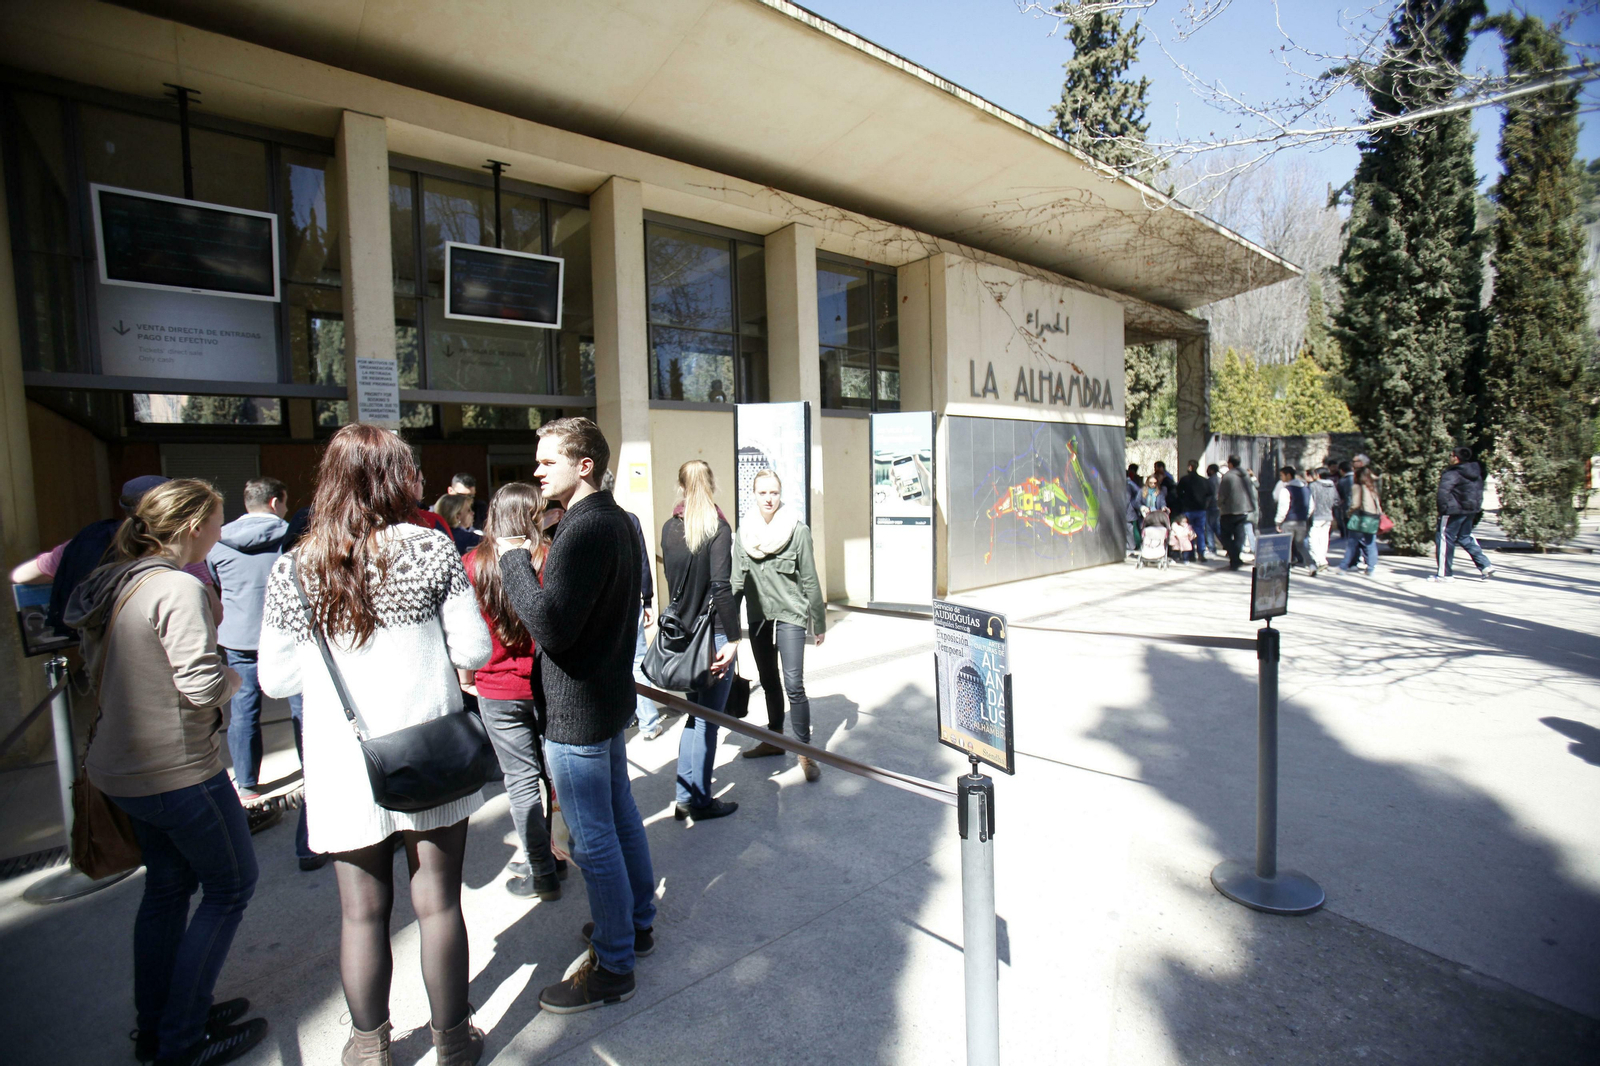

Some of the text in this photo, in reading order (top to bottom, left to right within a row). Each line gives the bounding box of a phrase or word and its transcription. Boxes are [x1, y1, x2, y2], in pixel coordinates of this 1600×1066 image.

[136, 323, 262, 340] VENTA DIRECTA DE ENTRADAS
[137, 333, 218, 346] PAGO EN EFECTIVO
[138, 355, 174, 364] Only cash
[167, 348, 188, 356] direct
[969, 359, 1114, 411] LA ALHAMBRA
[934, 601, 953, 612] Servicio
[934, 610, 981, 628] AUDIOGUÍAS
[936, 628, 969, 646] Exposición
[988, 641, 1001, 650] ARTE
[936, 640, 964, 658] Temporal
[982, 651, 1005, 672] AL-
[988, 688, 1005, 708] DA
[980, 702, 1005, 728] LUS
[973, 720, 1006, 740] ALHAMBR
